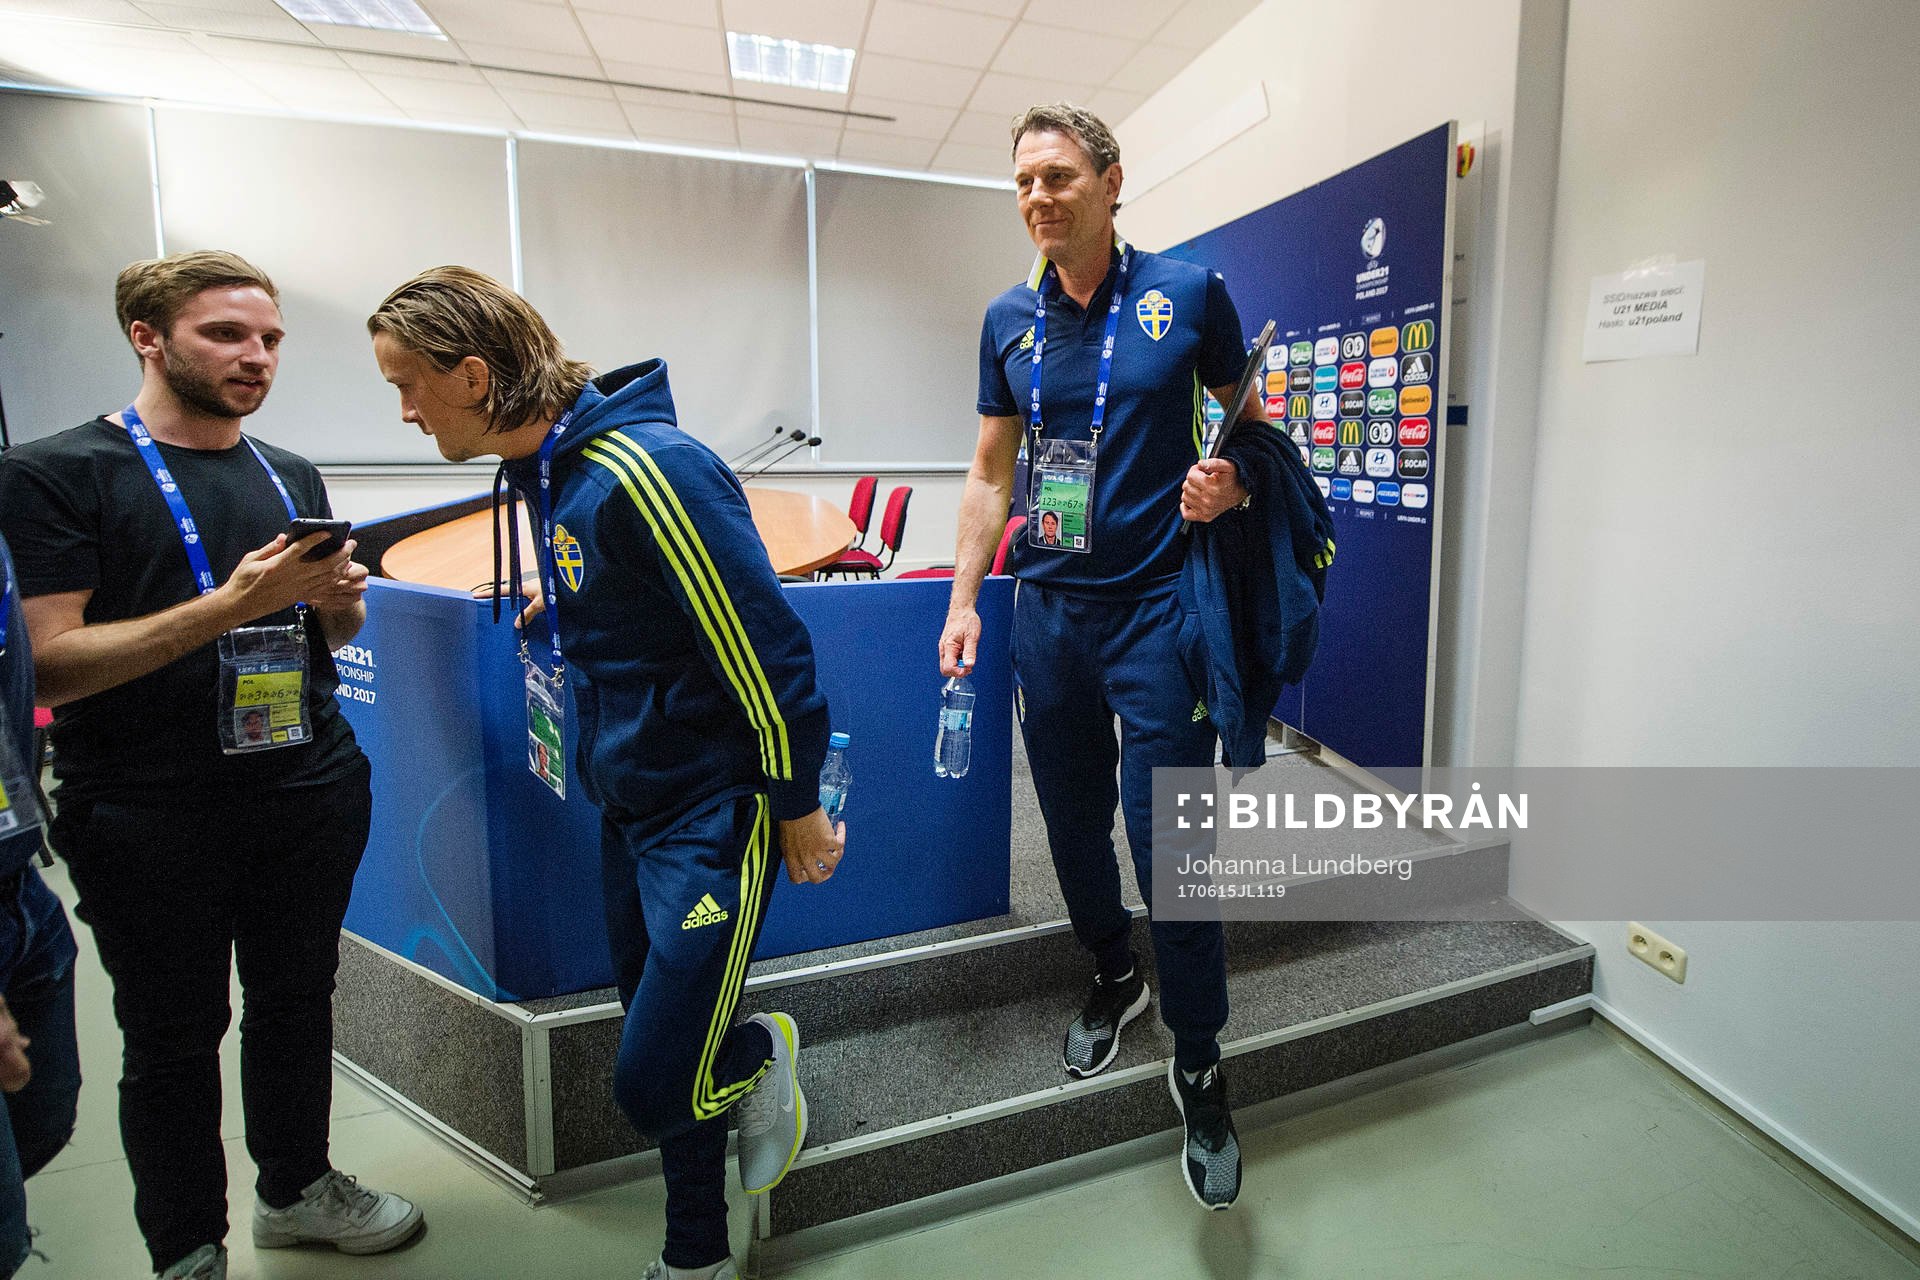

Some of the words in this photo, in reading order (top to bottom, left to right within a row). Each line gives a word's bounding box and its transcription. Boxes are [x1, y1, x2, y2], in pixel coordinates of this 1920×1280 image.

[1613, 304, 1632, 315] U21
[1634, 300, 1668, 313] MEDIA
[1628, 312, 1683, 326] u21poland
[1404, 459, 1427, 469] SOCAR
[353, 687, 377, 705] 2017
[681, 910, 729, 930] adidas
